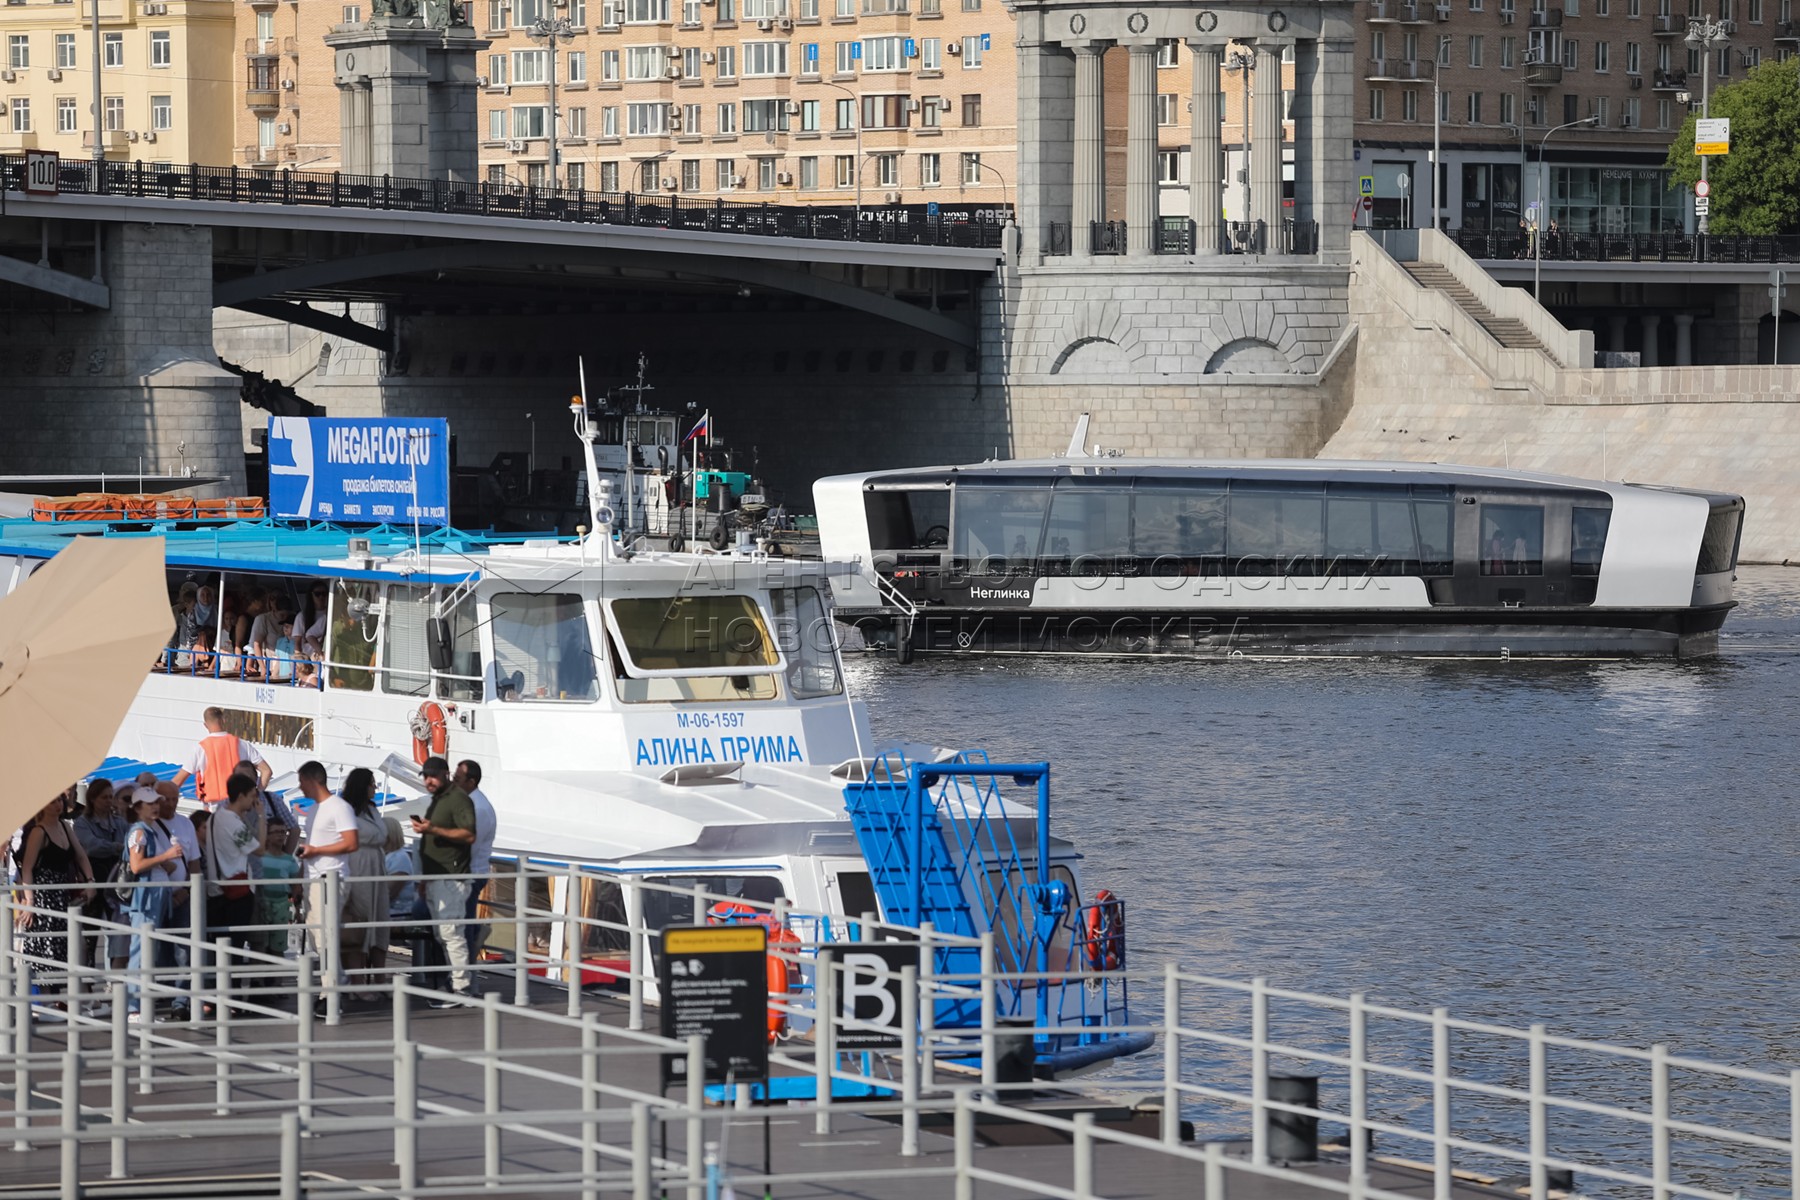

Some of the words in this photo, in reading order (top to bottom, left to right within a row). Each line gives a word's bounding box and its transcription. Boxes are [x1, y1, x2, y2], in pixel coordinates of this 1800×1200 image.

[30, 160, 55, 185] 10.0
[327, 426, 430, 465] MEGAFLOT.RU
[970, 586, 1030, 599] Неглинка
[636, 737, 716, 766] АЛИНА
[719, 735, 804, 763] ПРИМА
